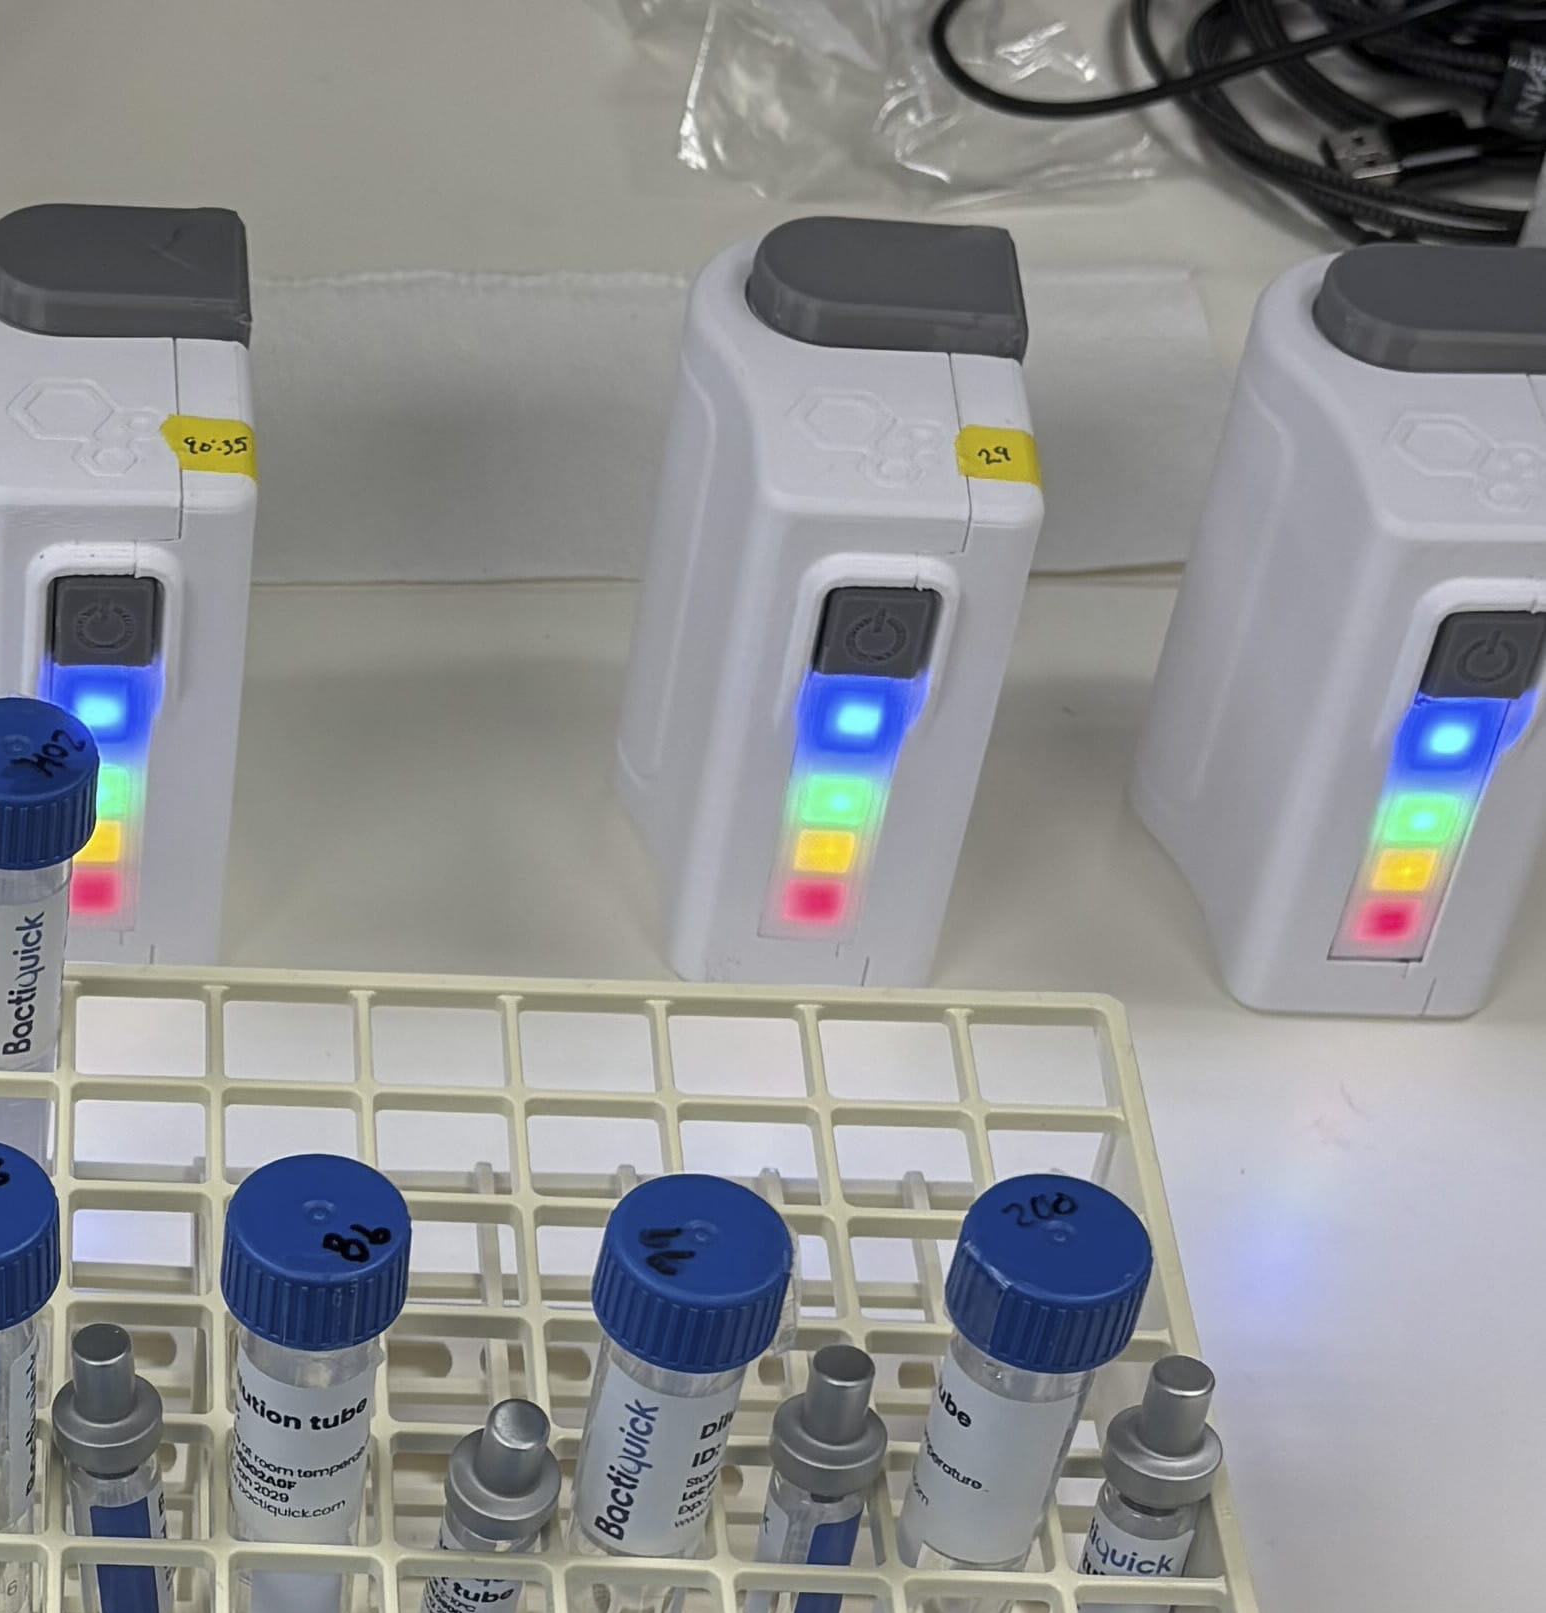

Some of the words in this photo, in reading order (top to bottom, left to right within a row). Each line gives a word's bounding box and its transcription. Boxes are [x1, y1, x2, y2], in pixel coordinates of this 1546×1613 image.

[977, 446, 1011, 466] 29
[2, 911, 46, 1055] Bactiquick
[309, 1398, 367, 1431] tube
[594, 1399, 660, 1541] Bactiquick
[254, 1481, 290, 1503] 2029
[453, 1581, 514, 1604] tube
